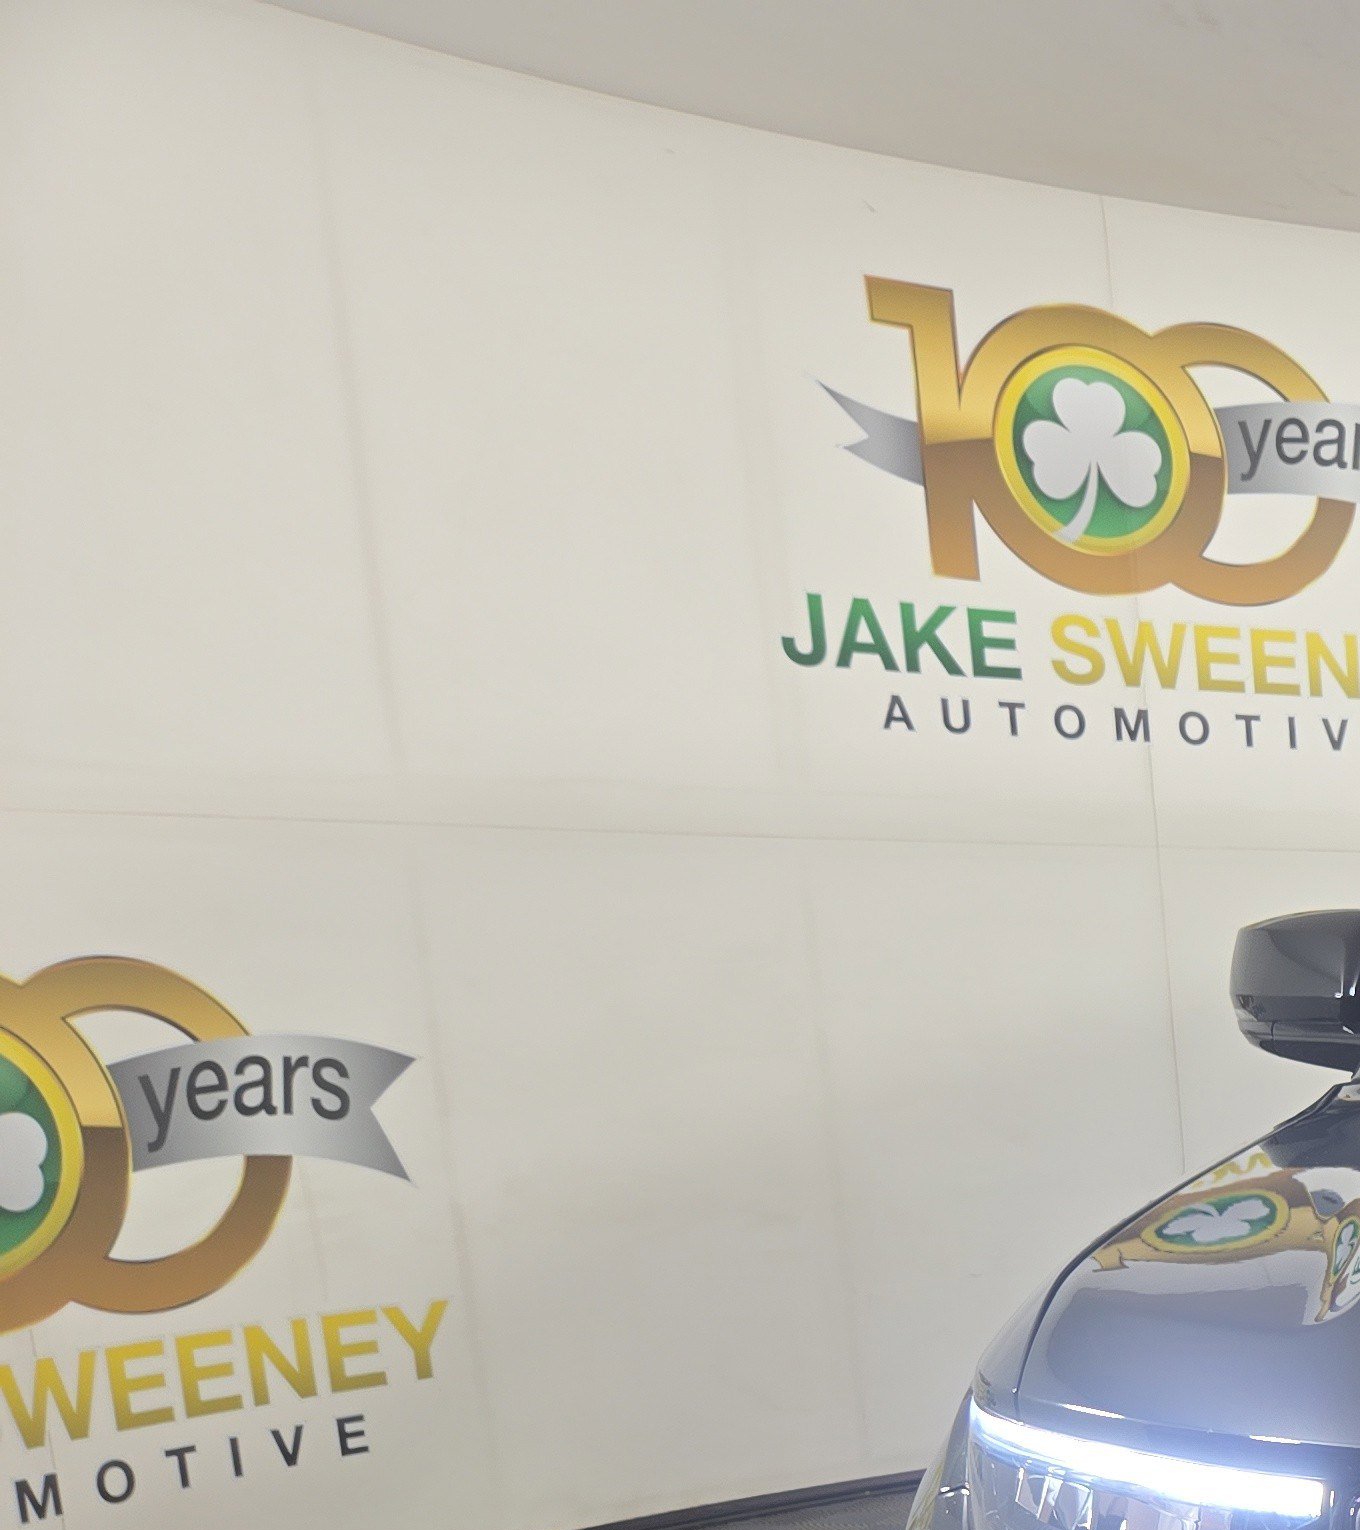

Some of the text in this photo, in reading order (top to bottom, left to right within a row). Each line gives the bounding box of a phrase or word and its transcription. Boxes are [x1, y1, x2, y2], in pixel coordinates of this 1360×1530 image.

[781, 592, 1023, 680] JAKE
[137, 1054, 352, 1153] years
[15, 1414, 370, 1524] MOTIVE
